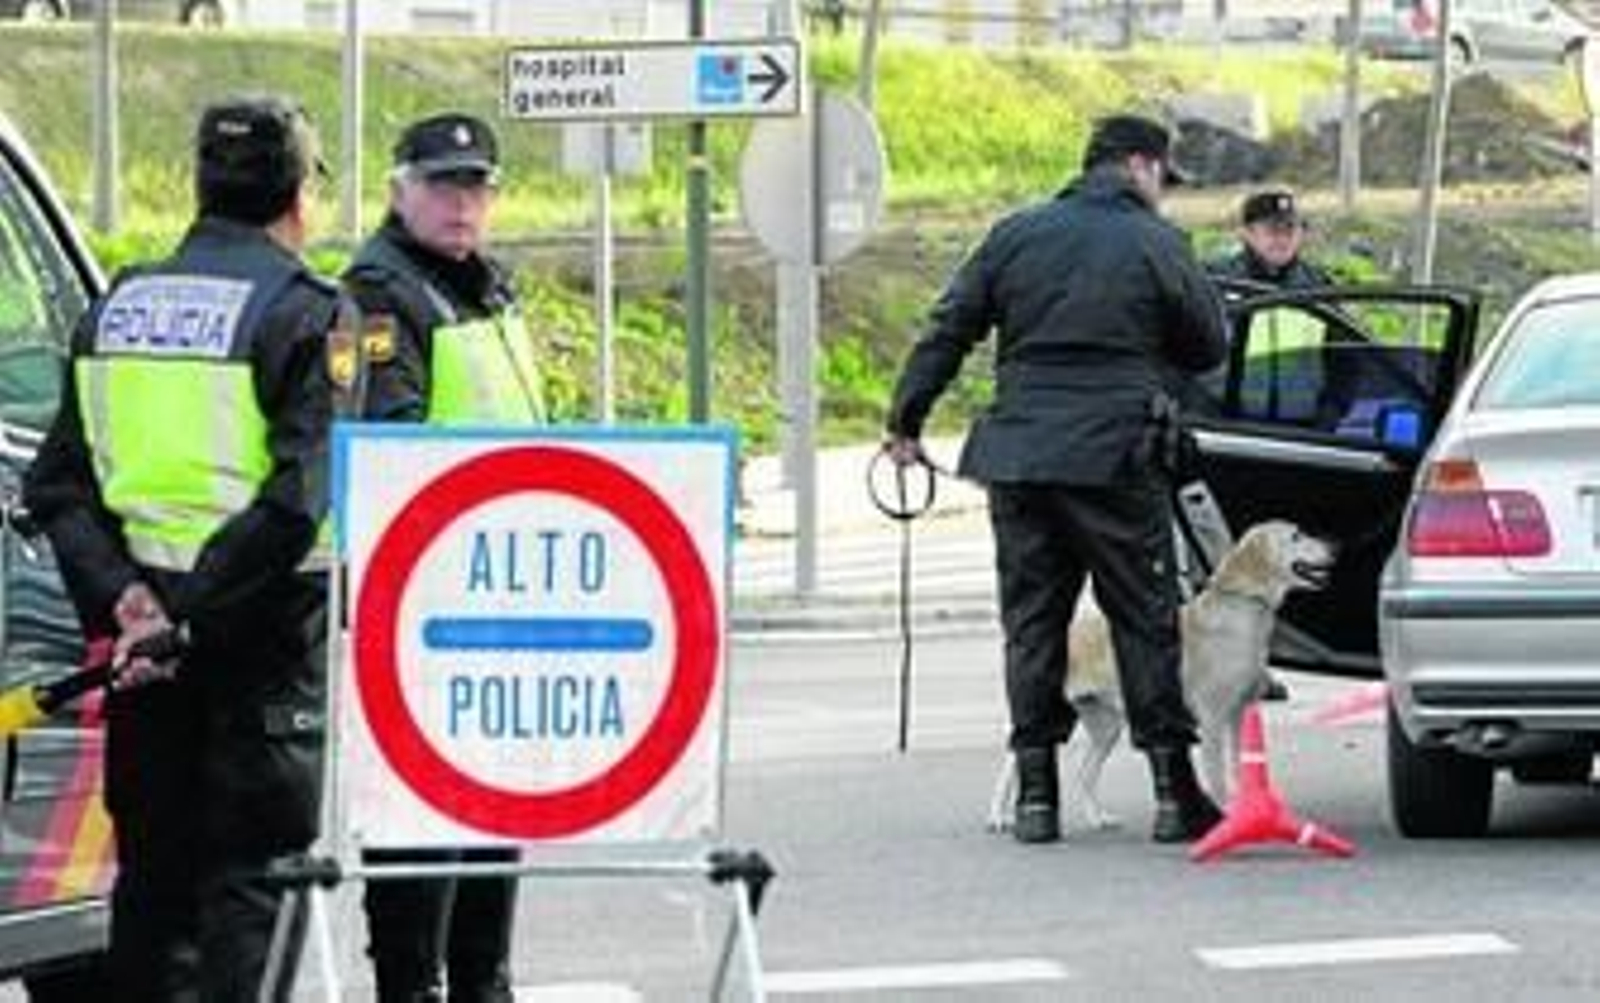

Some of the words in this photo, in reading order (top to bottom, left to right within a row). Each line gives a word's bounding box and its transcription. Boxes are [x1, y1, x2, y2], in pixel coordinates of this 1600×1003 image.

[512, 54, 626, 80] hospital
[513, 85, 615, 112] general
[467, 531, 606, 592] ALTO
[449, 675, 625, 738] POLICIA
